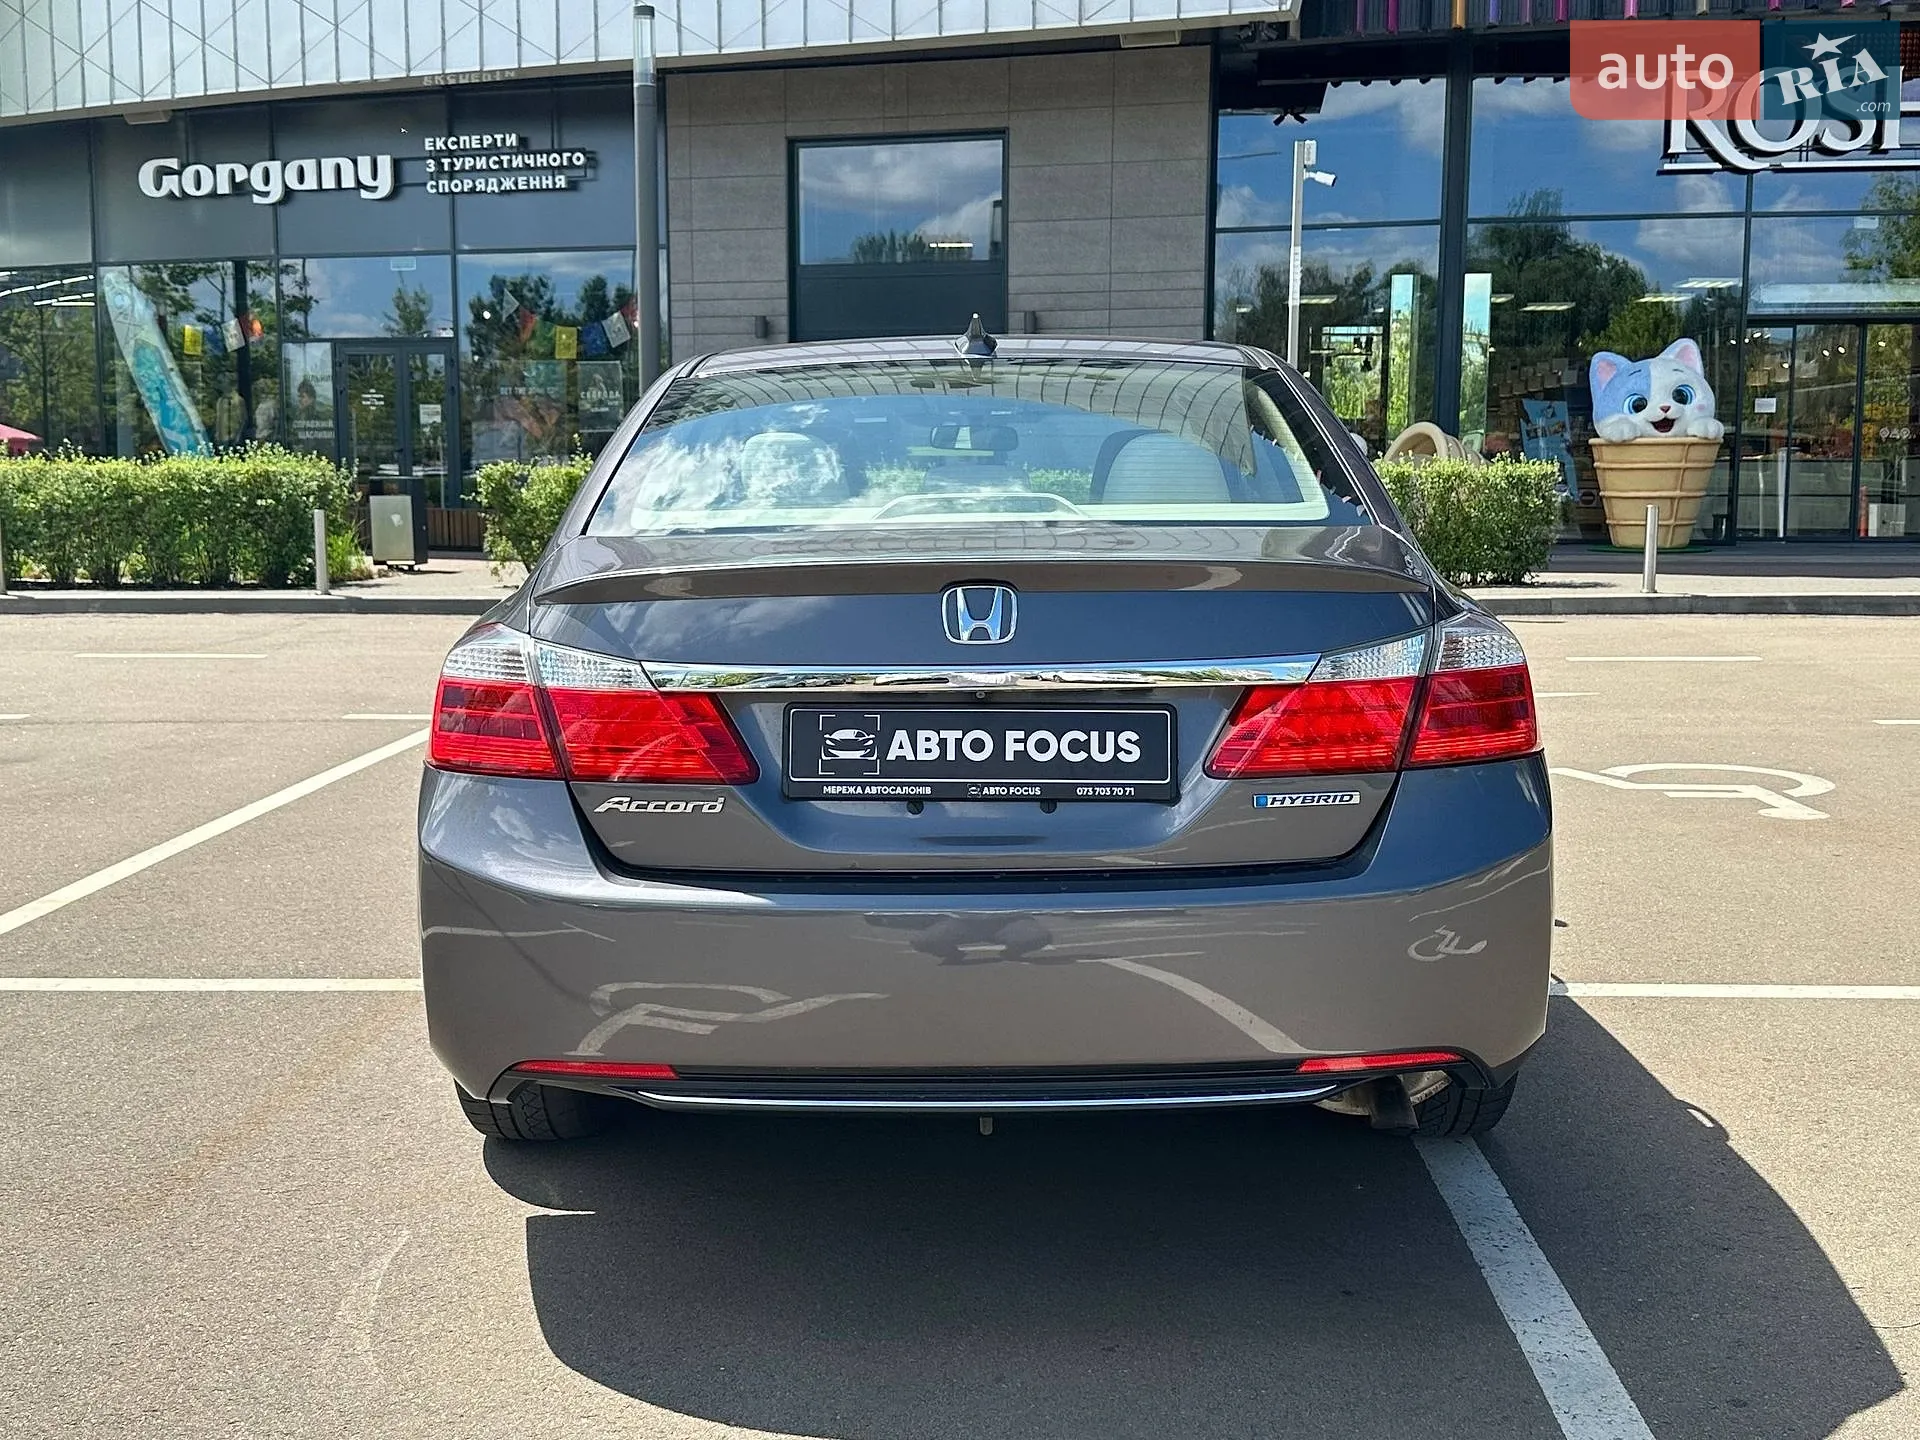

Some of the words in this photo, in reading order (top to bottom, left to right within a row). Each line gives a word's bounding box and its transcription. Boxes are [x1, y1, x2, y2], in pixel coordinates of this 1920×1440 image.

[424, 133, 517, 150] ЕКСПЕРТИ
[441, 152, 585, 172] ТУРИСТИЧНОГО
[138, 154, 395, 204] Gorgany
[426, 175, 567, 193] СПОРЯДЖЕННЯ
[886, 729, 994, 761] АВТО
[1005, 730, 1141, 763] FOCUS
[823, 785, 863, 795] МЕРЕЖА
[864, 786, 932, 795] АВТОСАЛОНІВ
[982, 786, 1007, 795] АВТО
[1009, 786, 1041, 796] FOCUS
[1076, 787, 1093, 796] 073
[1094, 787, 1111, 796] 703
[1112, 787, 1124, 796] 70
[1124, 787, 1135, 796] 71
[593, 796, 726, 813] Accord
[1269, 794, 1354, 806] HYBRID
